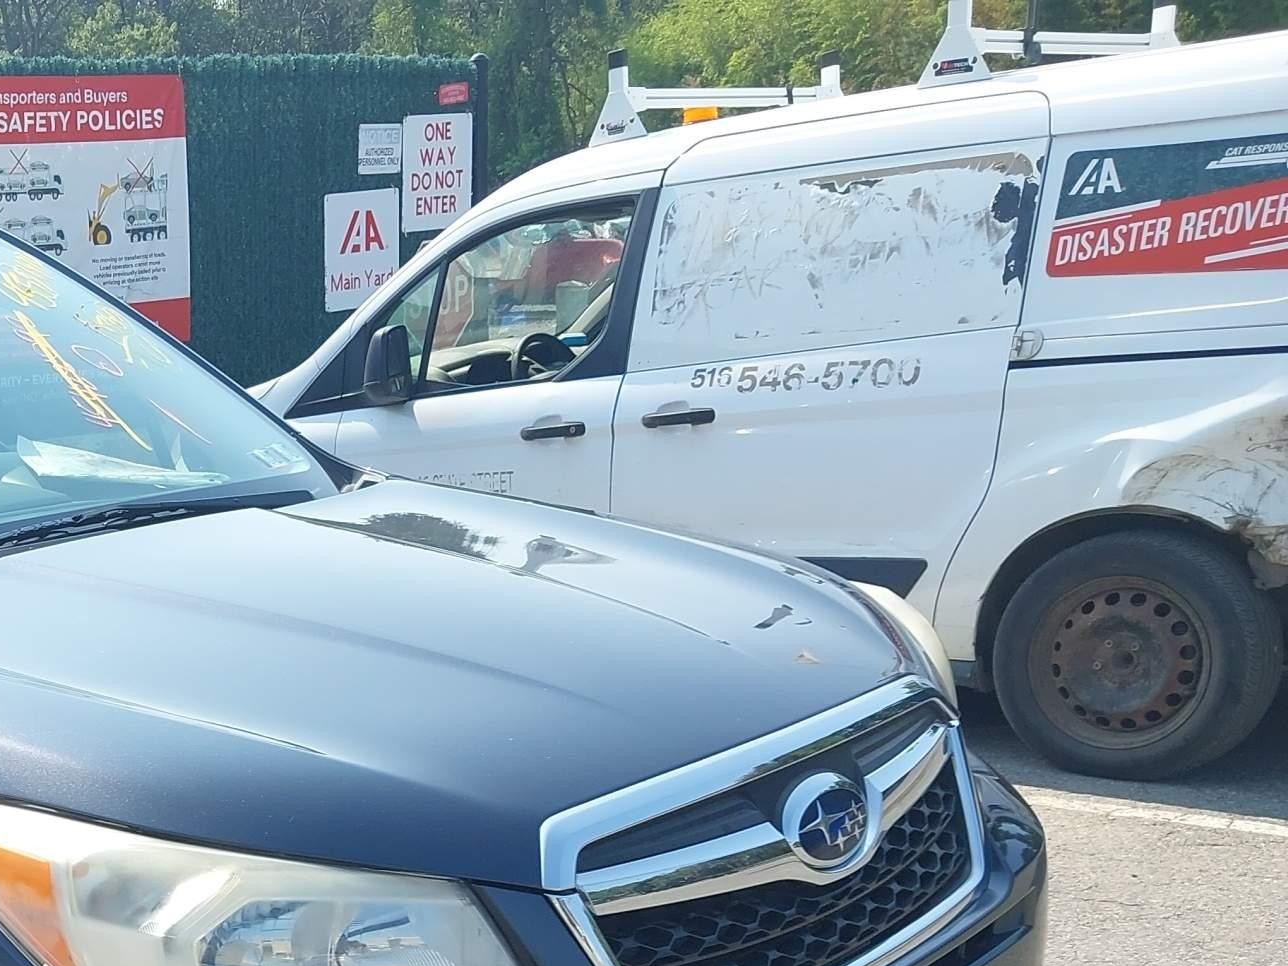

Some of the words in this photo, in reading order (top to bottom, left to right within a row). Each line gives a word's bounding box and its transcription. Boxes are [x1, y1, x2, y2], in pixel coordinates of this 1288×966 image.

[59, 88, 82, 104] and
[84, 88, 128, 106] Buyers
[76, 108, 164, 131] POLICIES
[361, 128, 400, 144] NOTICE
[424, 121, 453, 142] ONE
[364, 147, 394, 156] AUTHORIZED
[419, 146, 457, 167] WAY
[1225, 146, 1244, 156] CAT
[358, 157, 386, 167] PERSONNEL
[411, 173, 432, 191] DO
[435, 169, 464, 189] NOT
[415, 195, 457, 216] ENTER
[1054, 216, 1172, 266] DISASTER
[330, 272, 361, 292] Main
[690, 366, 733, 388] 516
[736, 358, 921, 393] 546-5700
